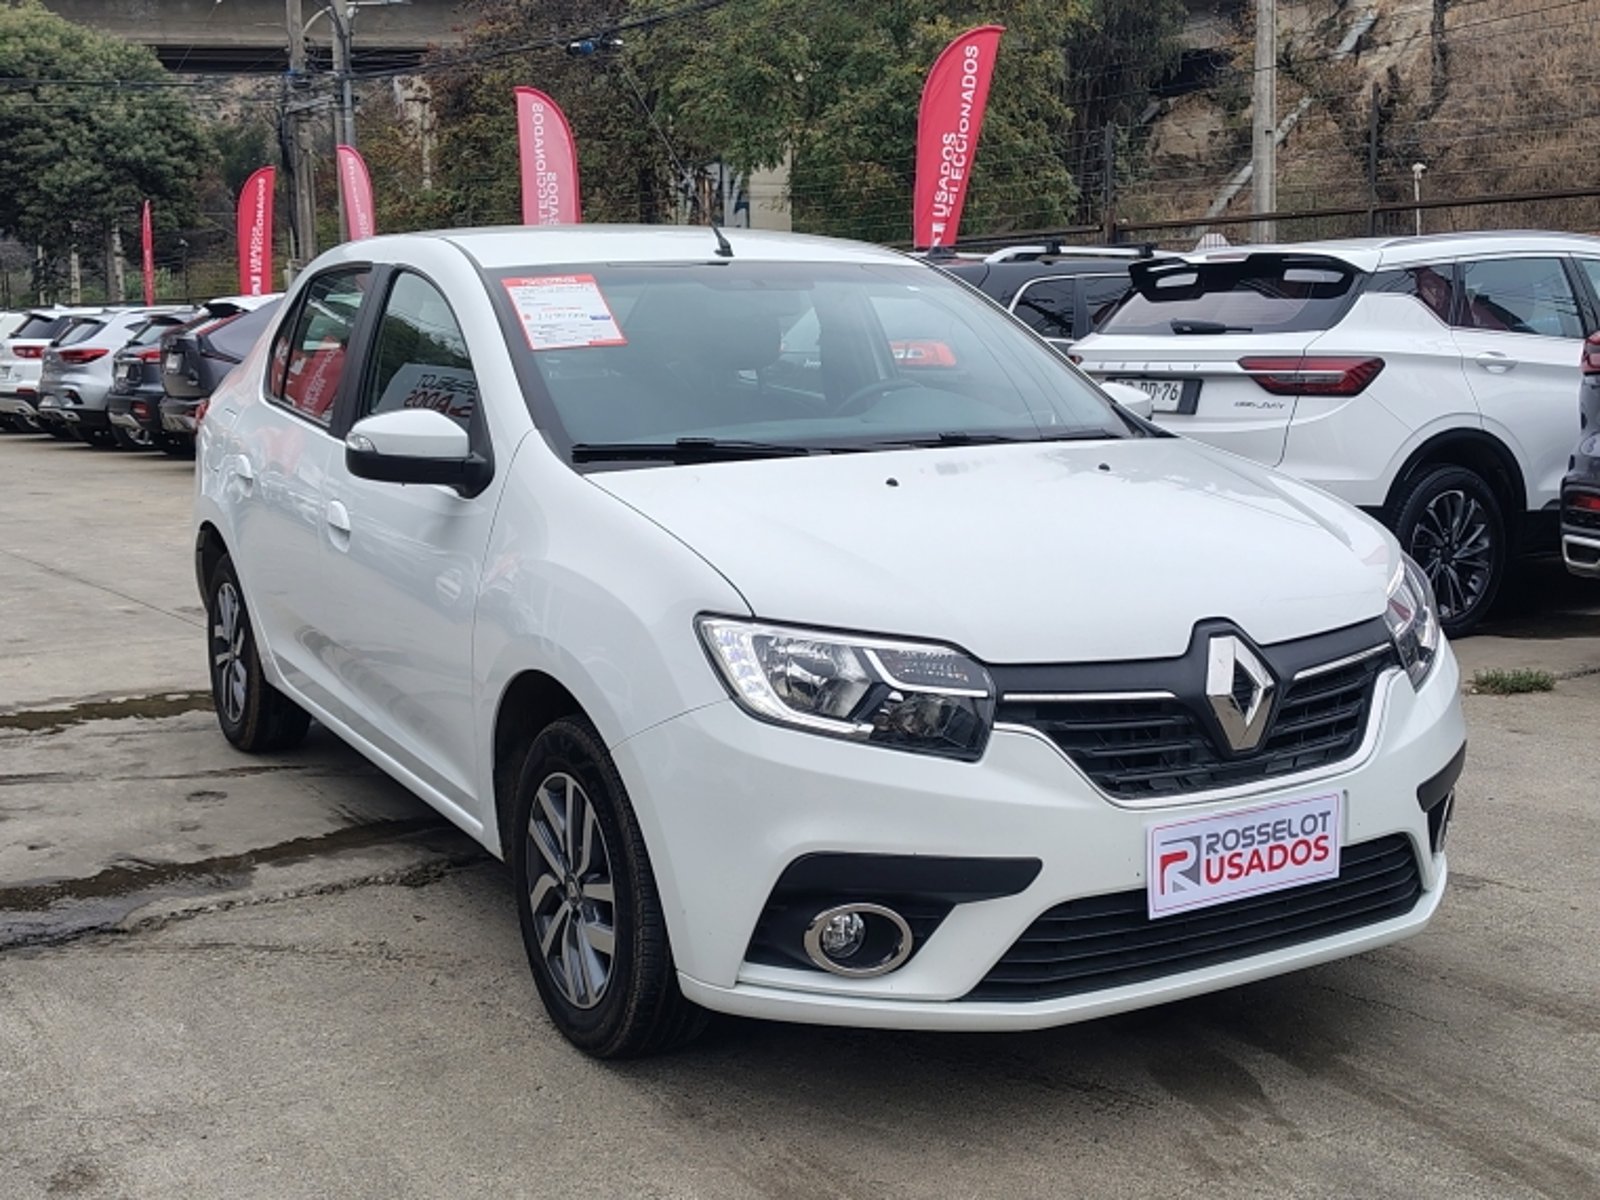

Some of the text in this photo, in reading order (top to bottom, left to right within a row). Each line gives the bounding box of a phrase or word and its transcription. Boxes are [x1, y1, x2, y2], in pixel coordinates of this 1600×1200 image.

[933, 132, 957, 217] USADOS
[1205, 810, 1331, 855] ROSSELOT
[1205, 835, 1329, 884] USADOS
